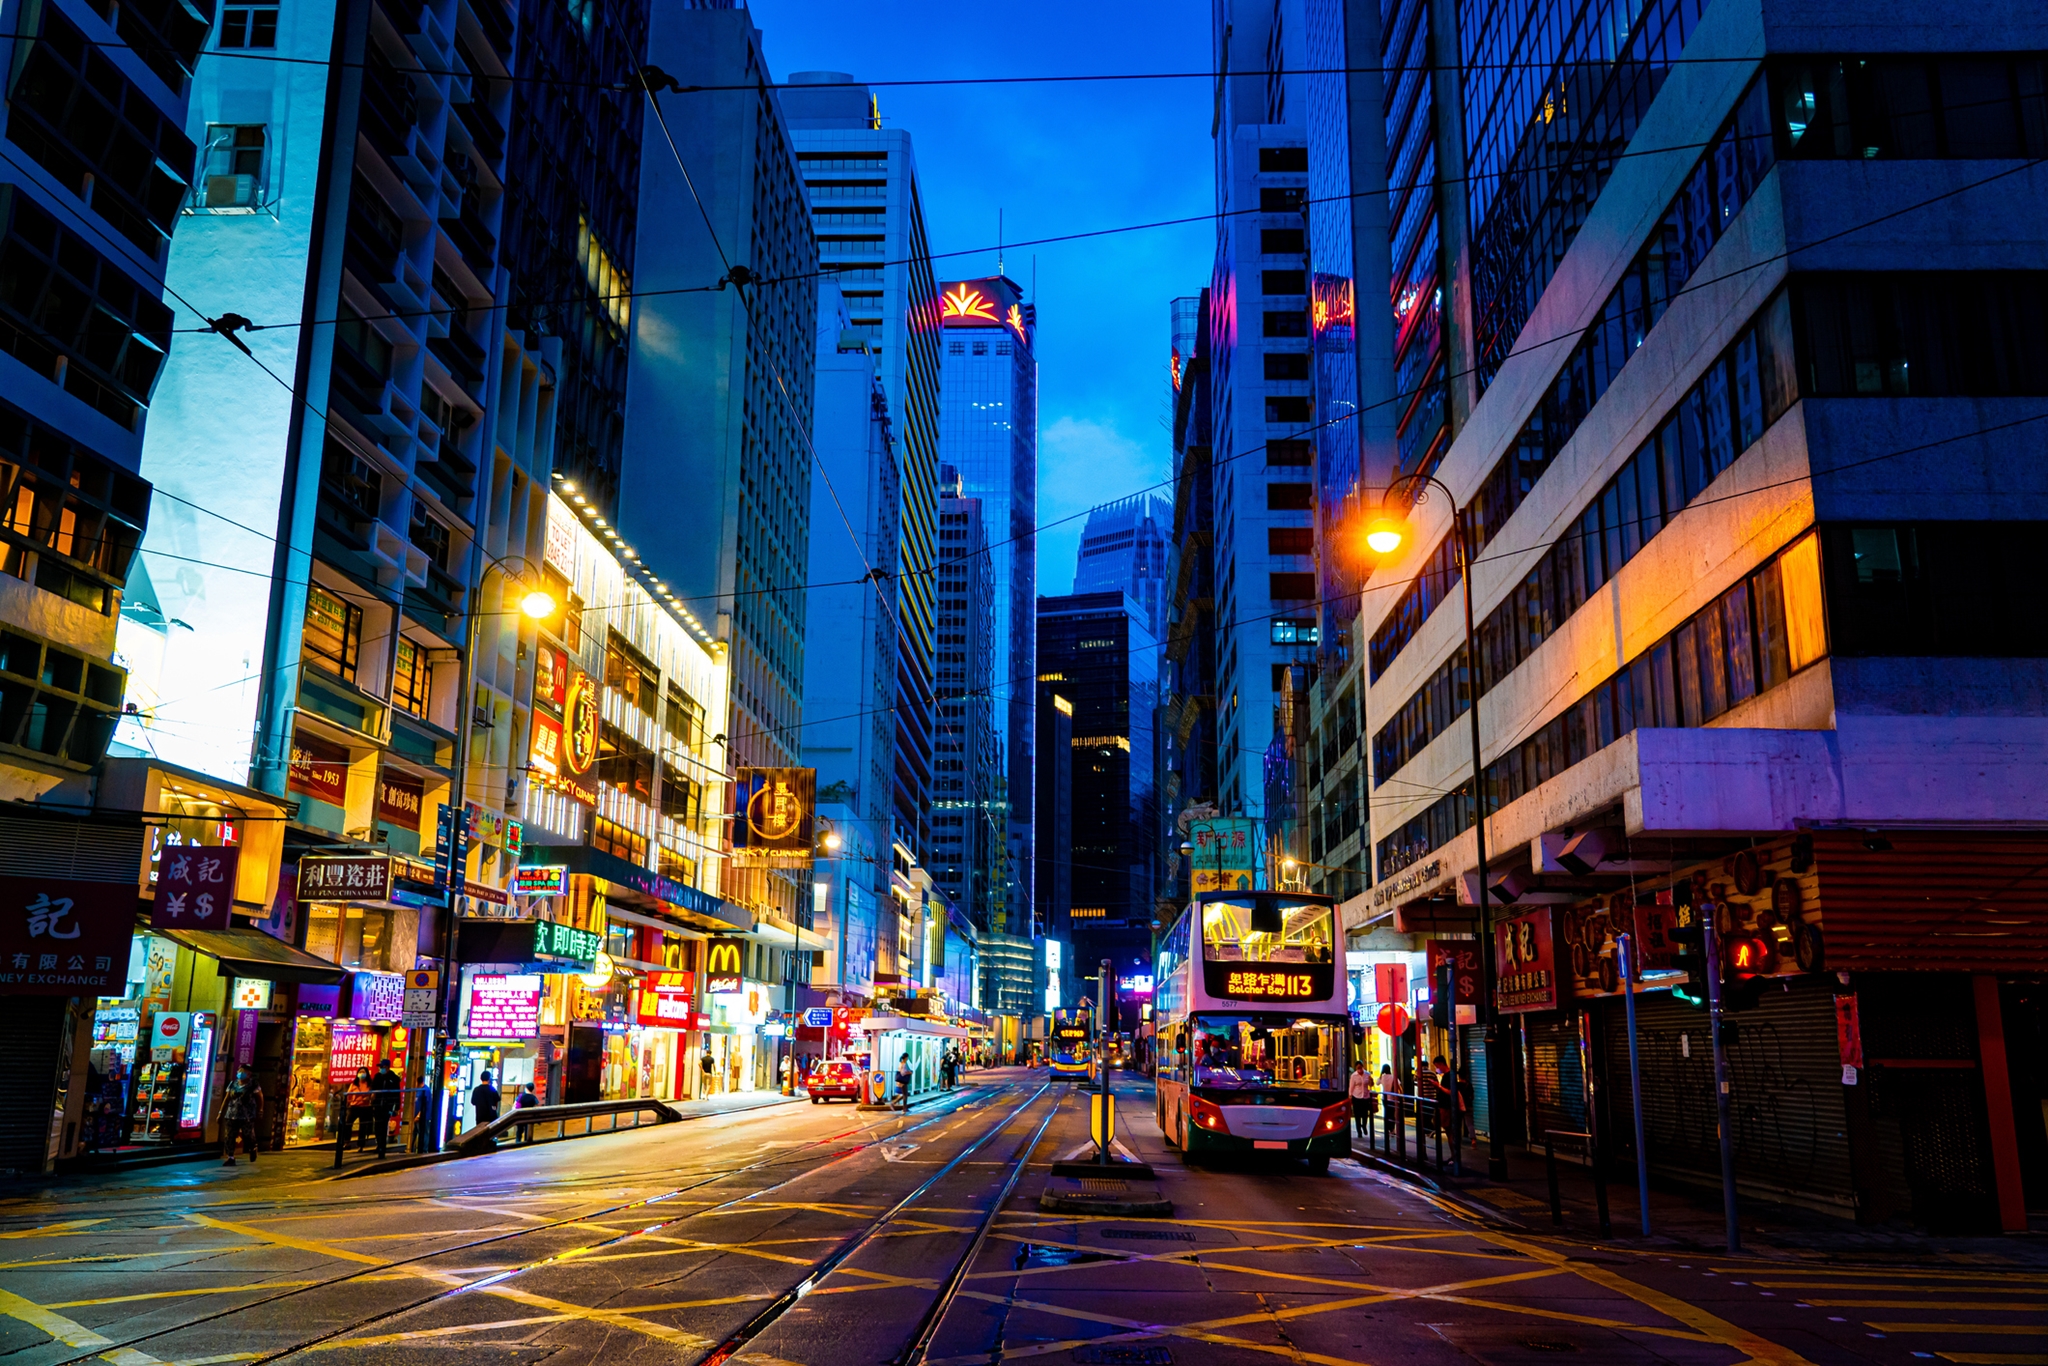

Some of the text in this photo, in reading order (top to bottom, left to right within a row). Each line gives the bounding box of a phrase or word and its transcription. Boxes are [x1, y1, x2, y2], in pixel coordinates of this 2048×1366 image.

[322, 769, 340, 787] 1953
[168, 854, 224, 886] 成記
[304, 864, 385, 888] 利豐瓷莊
[25, 893, 81, 939] 記
[553, 924, 597, 960] 即時至
[12, 953, 112, 972] 有限公司
[28, 973, 108, 986] EXCHANGE
[1228, 972, 1286, 987] 卑路乍灣
[1287, 975, 1312, 996] 113
[425, 990, 431, 998] 7
[1228, 985, 1286, 996] Belcher Bay
[425, 1002, 430, 1010] 7
